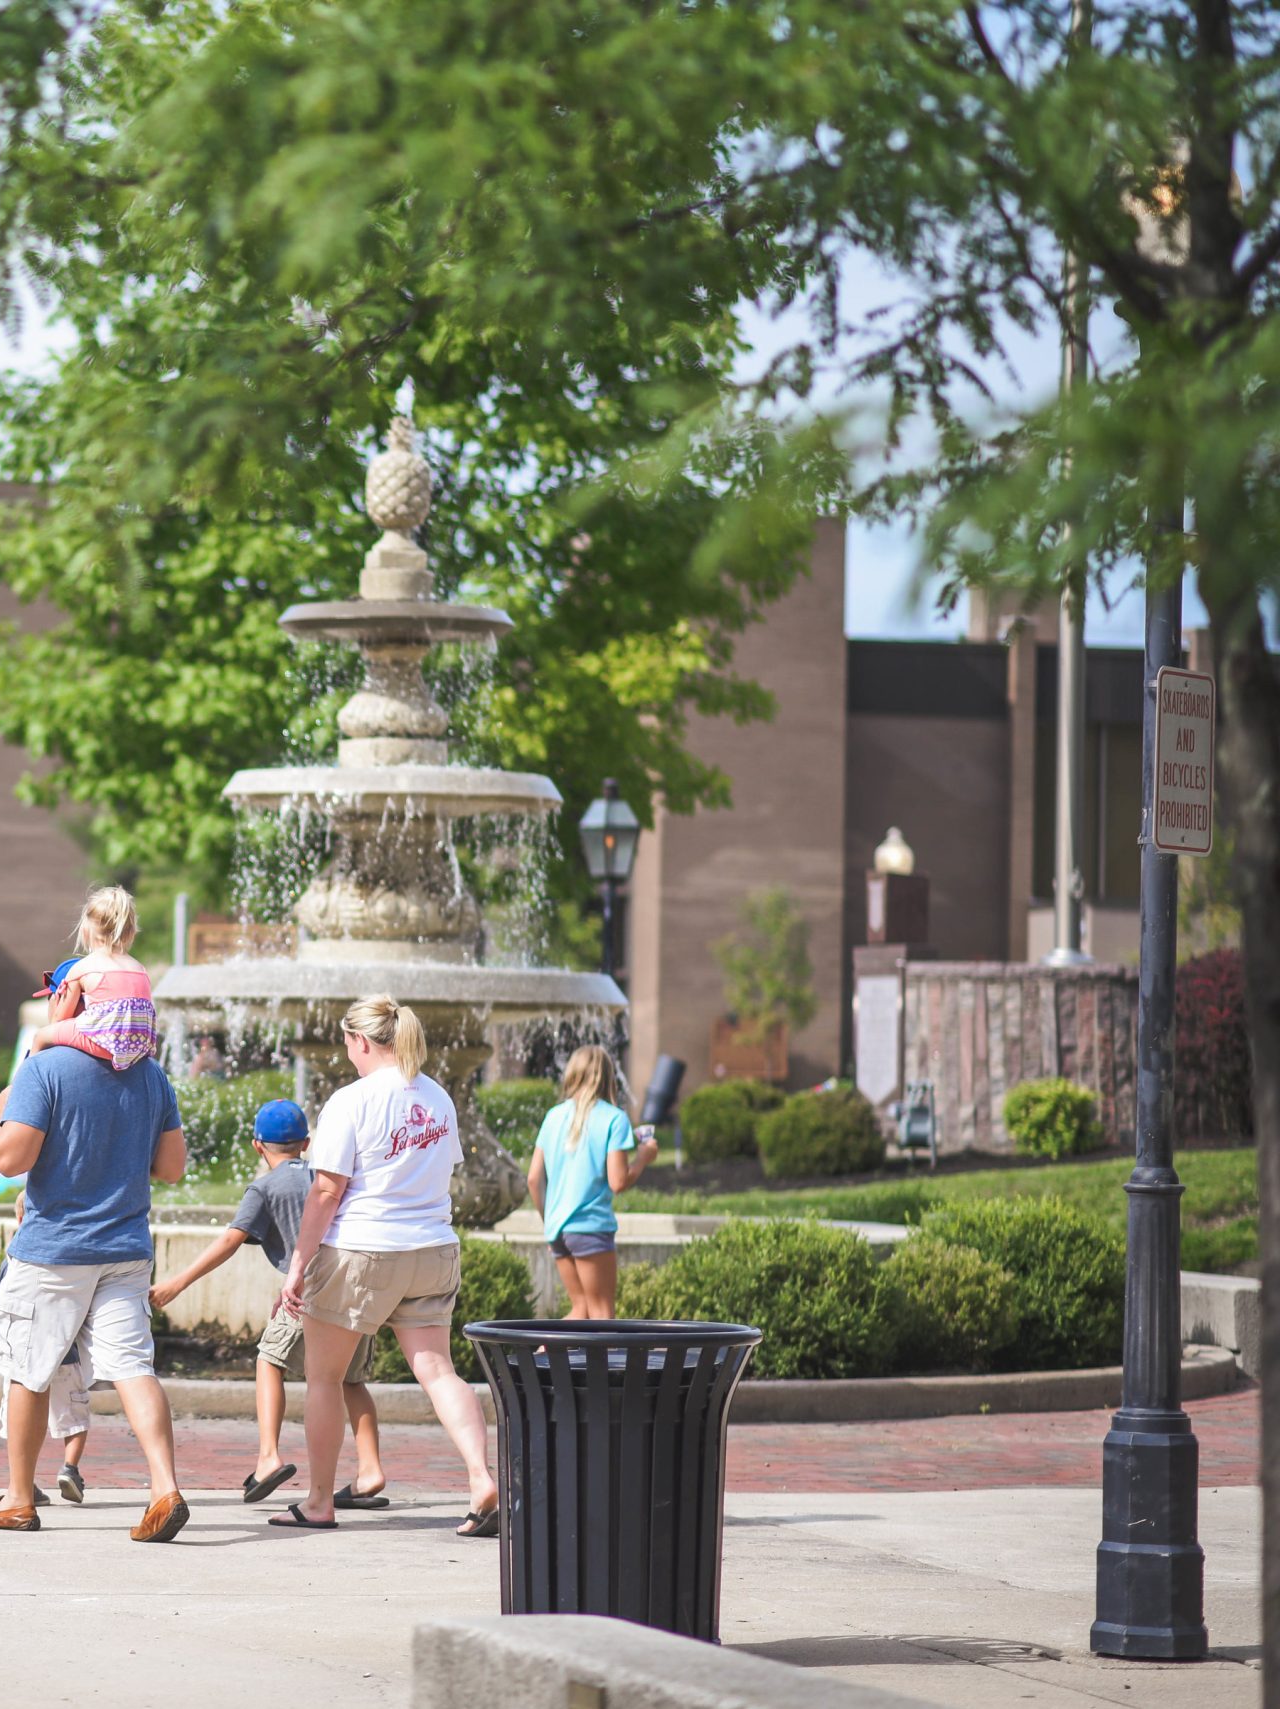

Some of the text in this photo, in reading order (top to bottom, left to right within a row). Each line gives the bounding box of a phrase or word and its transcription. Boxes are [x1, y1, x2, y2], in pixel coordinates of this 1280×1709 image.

[1162, 689, 1210, 720] SKATEBOARDS
[1176, 727, 1195, 753] AND
[1163, 762, 1206, 791] BICYCLES
[1160, 801, 1208, 831] PROHIBITED
